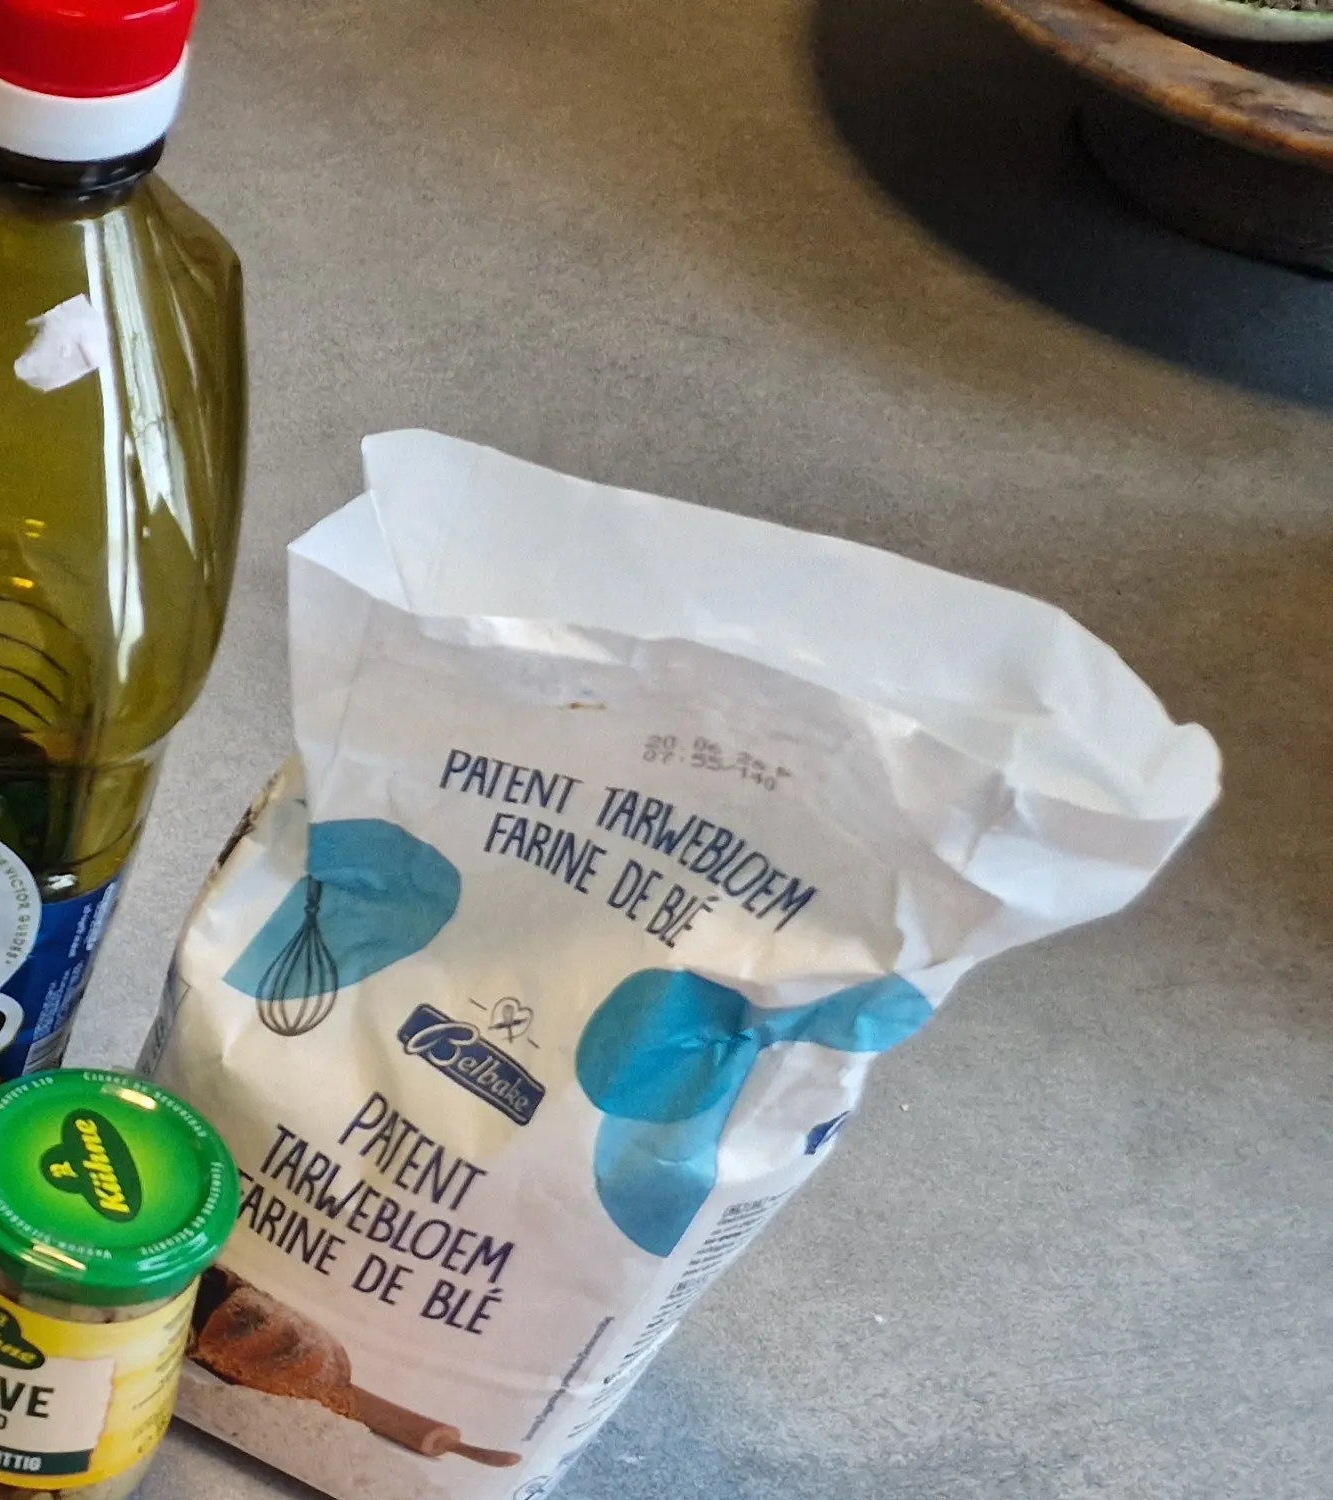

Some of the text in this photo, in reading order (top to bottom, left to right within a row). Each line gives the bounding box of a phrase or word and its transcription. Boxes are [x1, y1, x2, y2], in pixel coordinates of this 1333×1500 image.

[439, 748, 820, 934] PATENT TARWEBLOEM
[483, 812, 722, 949] FARINE DE BLÉ
[405, 1021, 530, 1112] Belbake
[75, 1118, 131, 1214] Kühne
[258, 1123, 514, 1285] TARWEBLOEM
[338, 1091, 488, 1213] PATENT
[234, 1170, 504, 1337] ARINE DE BLÉ
